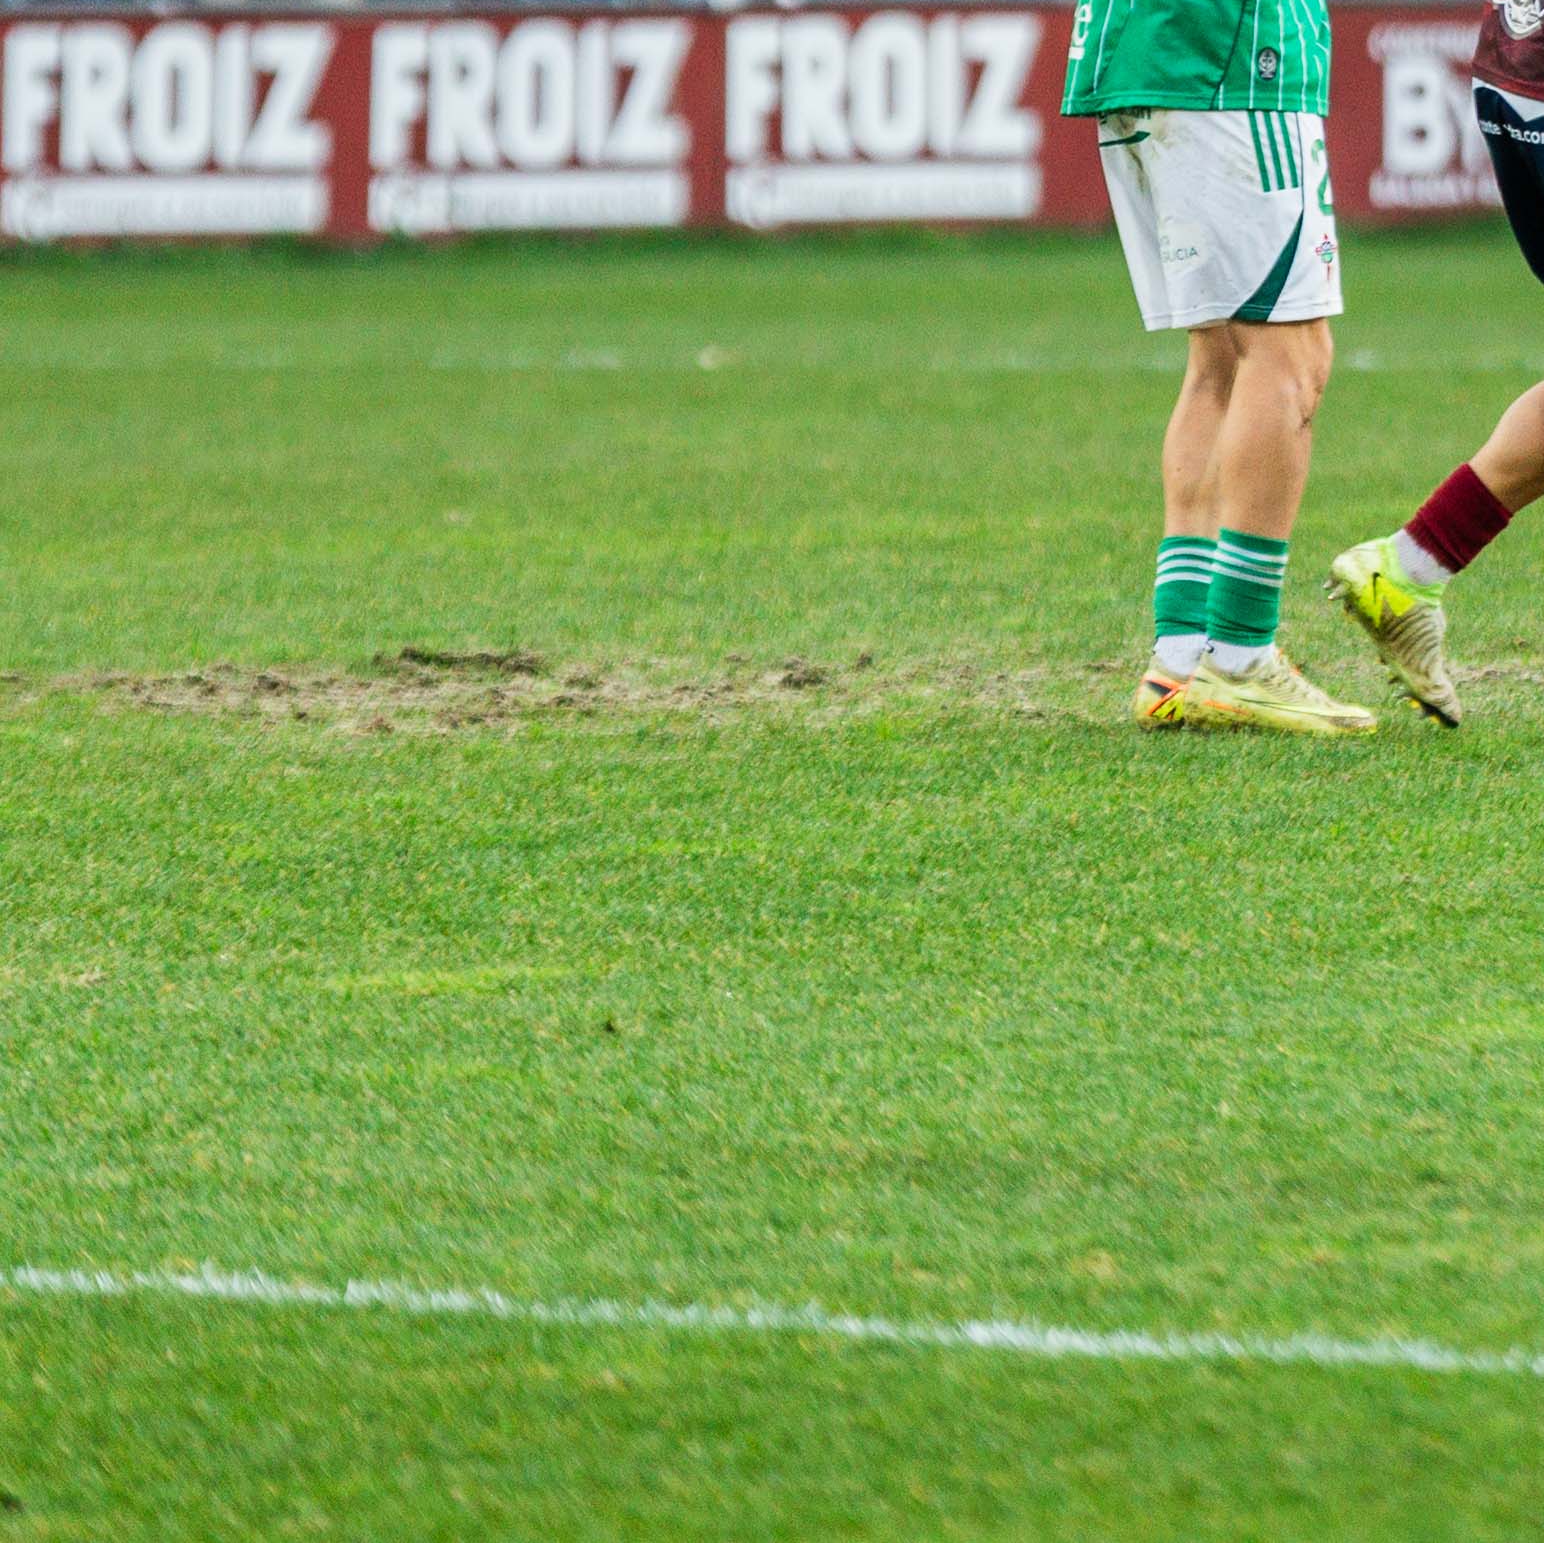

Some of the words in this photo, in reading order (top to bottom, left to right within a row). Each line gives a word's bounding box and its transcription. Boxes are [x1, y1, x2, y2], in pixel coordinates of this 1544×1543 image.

[2, 19, 337, 173] FROIZ
[369, 17, 693, 167] FROIZ
[724, 12, 1043, 162] FROIZ
